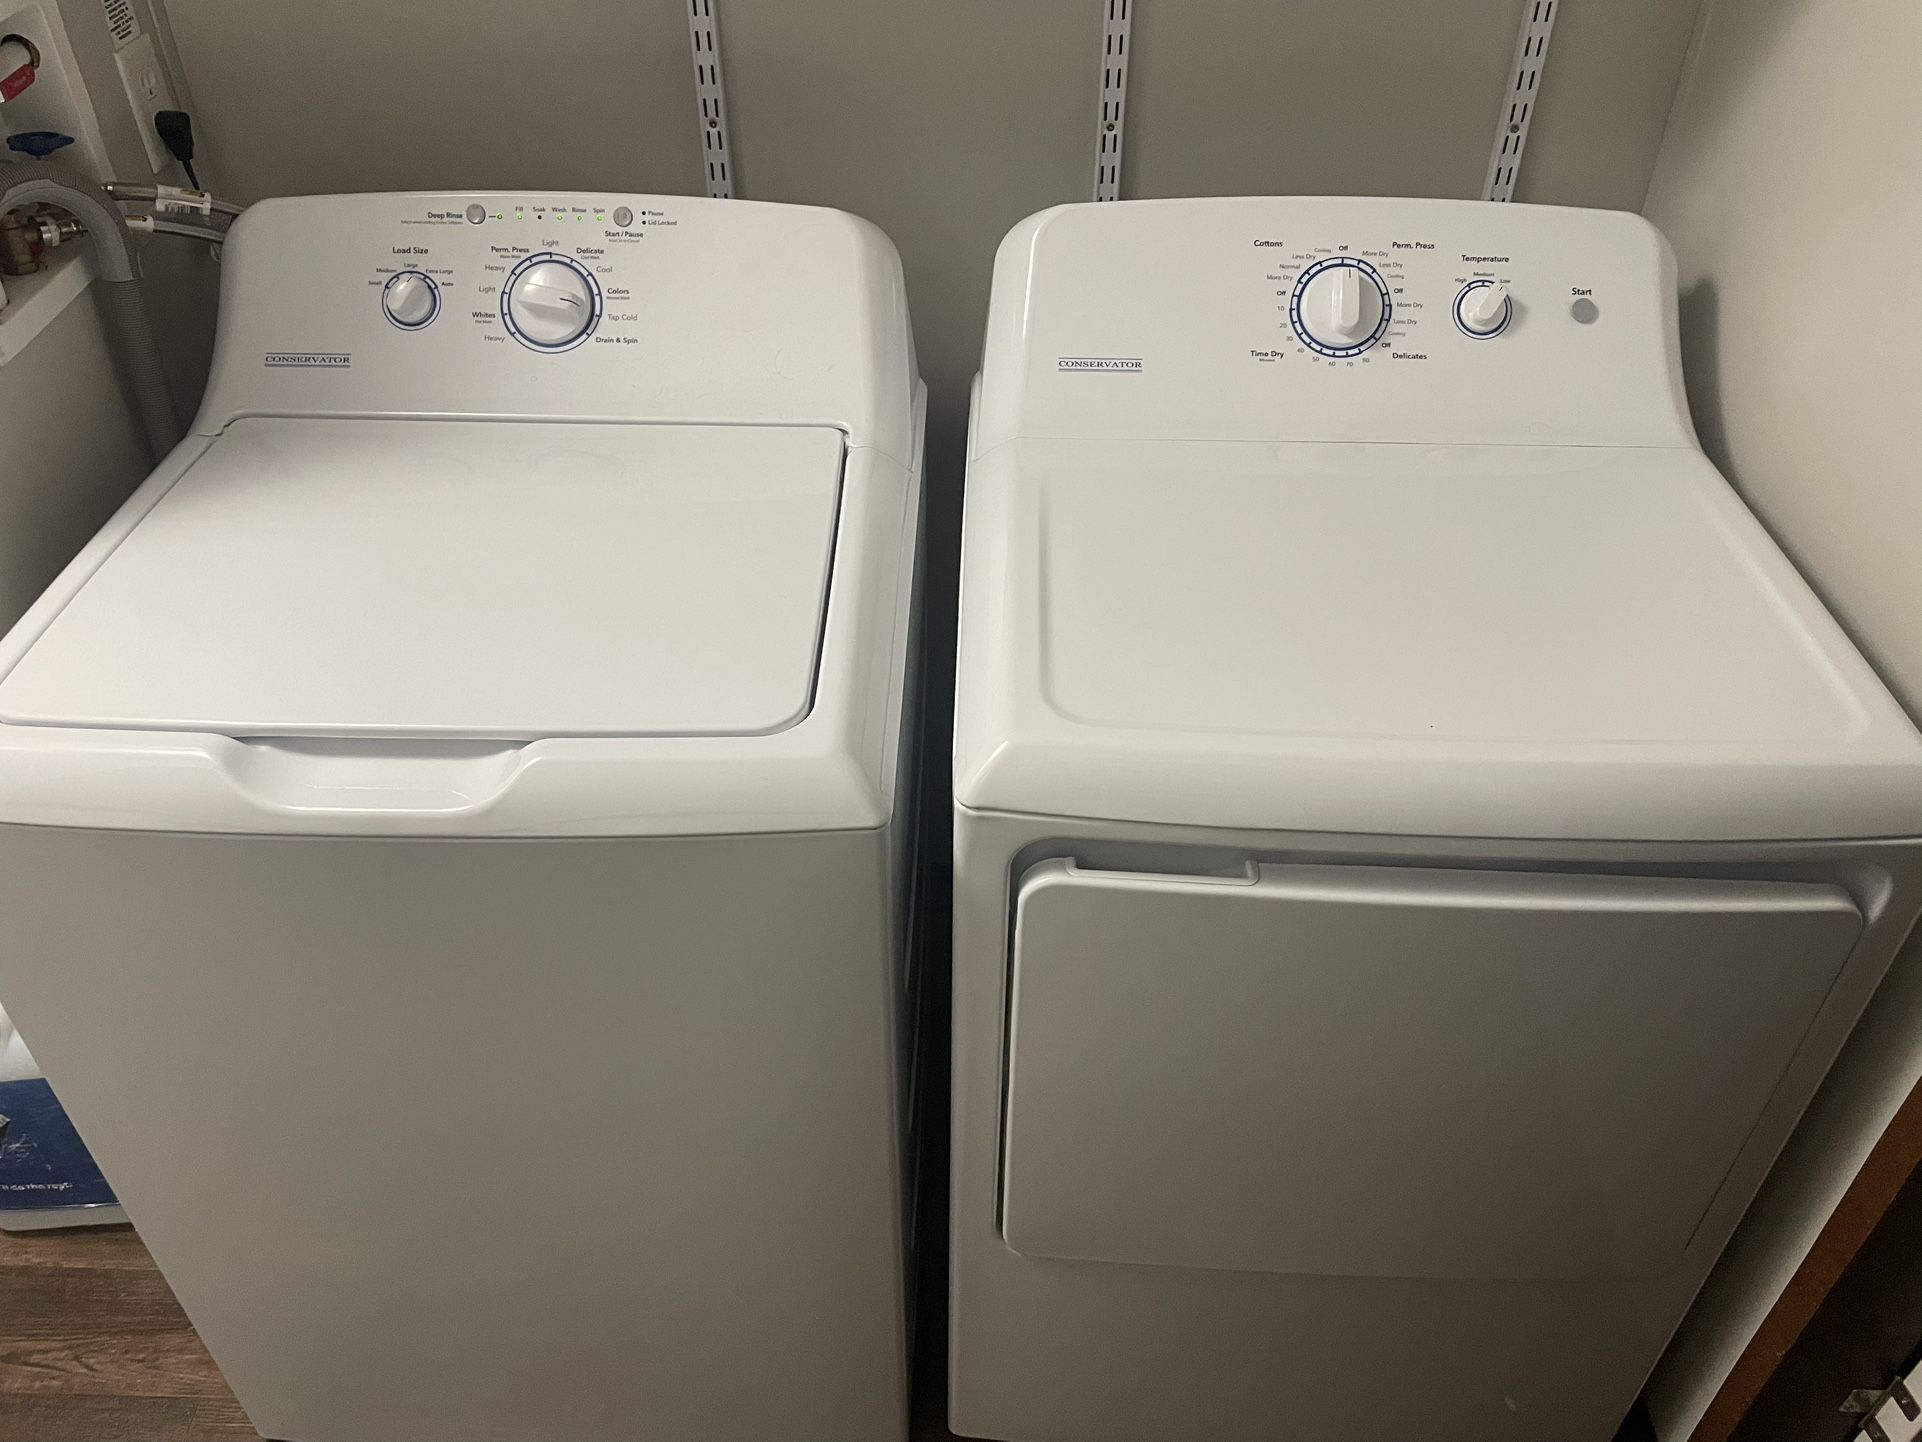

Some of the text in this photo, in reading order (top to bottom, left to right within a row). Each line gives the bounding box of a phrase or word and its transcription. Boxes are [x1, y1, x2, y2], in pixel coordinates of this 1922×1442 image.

[541, 239, 560, 248] Light
[1253, 239, 1284, 247] Cottons
[1392, 241, 1435, 249] Perm. Press
[392, 246, 429, 254] Load Size
[1378, 250, 1389, 258] Dry
[1305, 253, 1317, 261] Dry
[1461, 254, 1510, 264] Temperature
[485, 264, 506, 272] Heavy
[596, 265, 613, 273] Cool
[1392, 261, 1404, 269] Dry
[478, 286, 496, 294] Light
[607, 287, 630, 295] Colors
[1571, 287, 1593, 296] Start
[608, 313, 638, 321] Tap Cold
[484, 335, 506, 343] Heavy
[622, 336, 639, 344] Spin
[1270, 350, 1285, 359] Dry
[1392, 352, 1428, 360] Delicates
[265, 355, 350, 364] CONSERVATOR
[1058, 360, 1142, 368] CONSERVATOR
